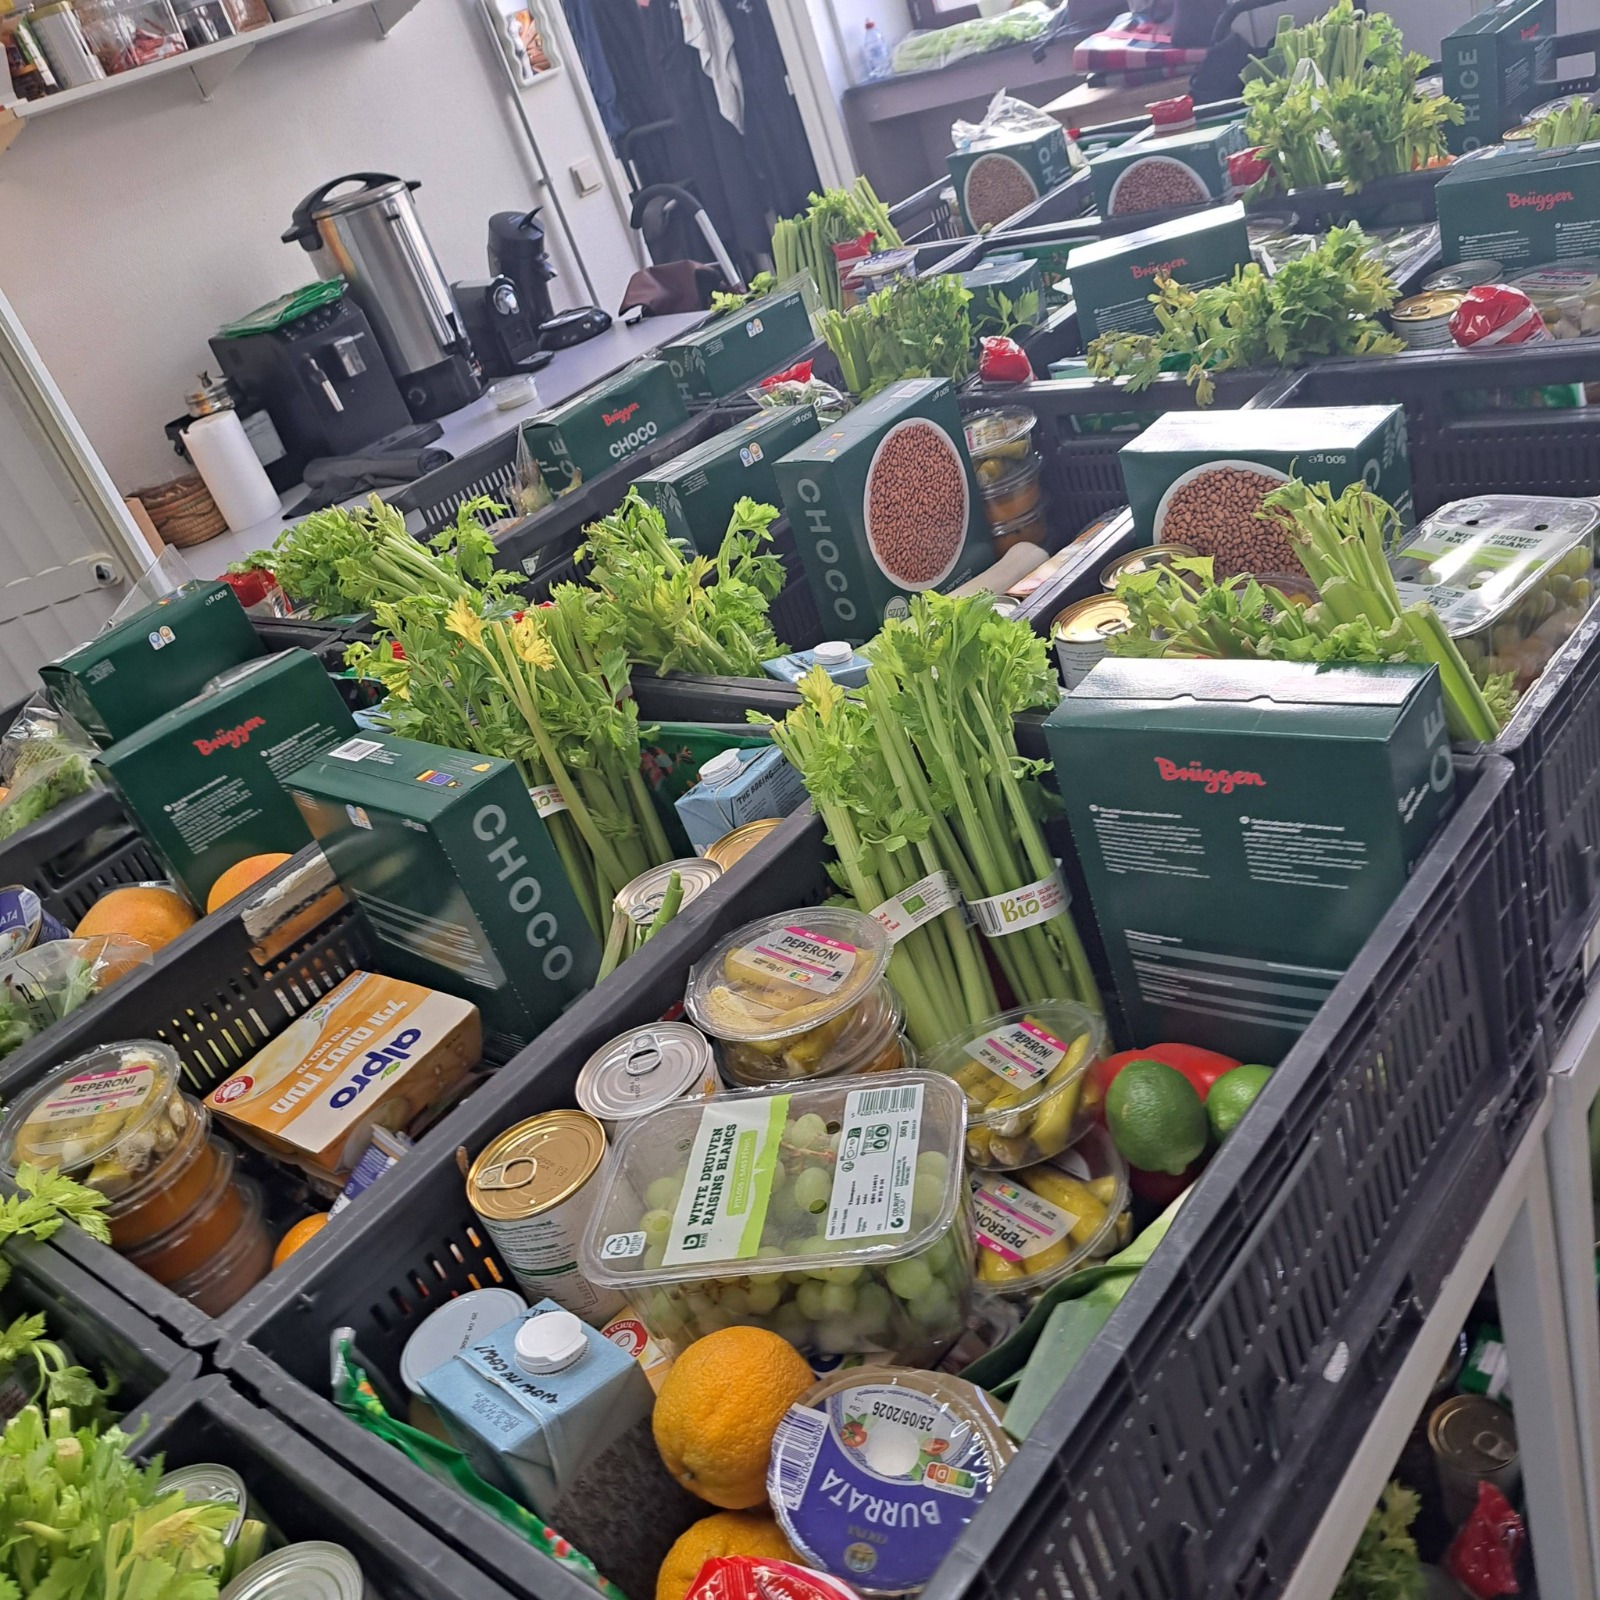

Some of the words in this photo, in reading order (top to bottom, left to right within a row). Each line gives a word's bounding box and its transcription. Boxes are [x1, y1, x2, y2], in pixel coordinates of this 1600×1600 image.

[1506, 191, 1575, 211] Brüggen
[602, 402, 640, 427] Brüggen
[609, 421, 658, 458] CHOCO
[797, 479, 857, 621] CHOCO
[192, 716, 266, 756] Brüggen
[1154, 757, 1266, 794] Brüggen
[736, 790, 751, 805] THE
[473, 804, 573, 981] CHOCO
[781, 936, 842, 962] PEPERONI
[270, 1072, 321, 1115] מעדן
[317, 1028, 375, 1072] בטעם
[373, 999, 408, 1029] וניל
[1010, 1031, 1053, 1059] PEPERONI
[70, 1075, 137, 1094] PEPERONI
[329, 1028, 421, 1109] alpro
[688, 1186, 709, 1226] WITTE
[700, 1127, 724, 1183] DRUIVEN
[701, 1175, 725, 1226] RAISINS
[716, 1123, 737, 1171] BLANCS
[892, 1192, 900, 1216] COLRUYT
[872, 1400, 935, 1432] 25/05/2026
[820, 1468, 942, 1528] BURRATA
